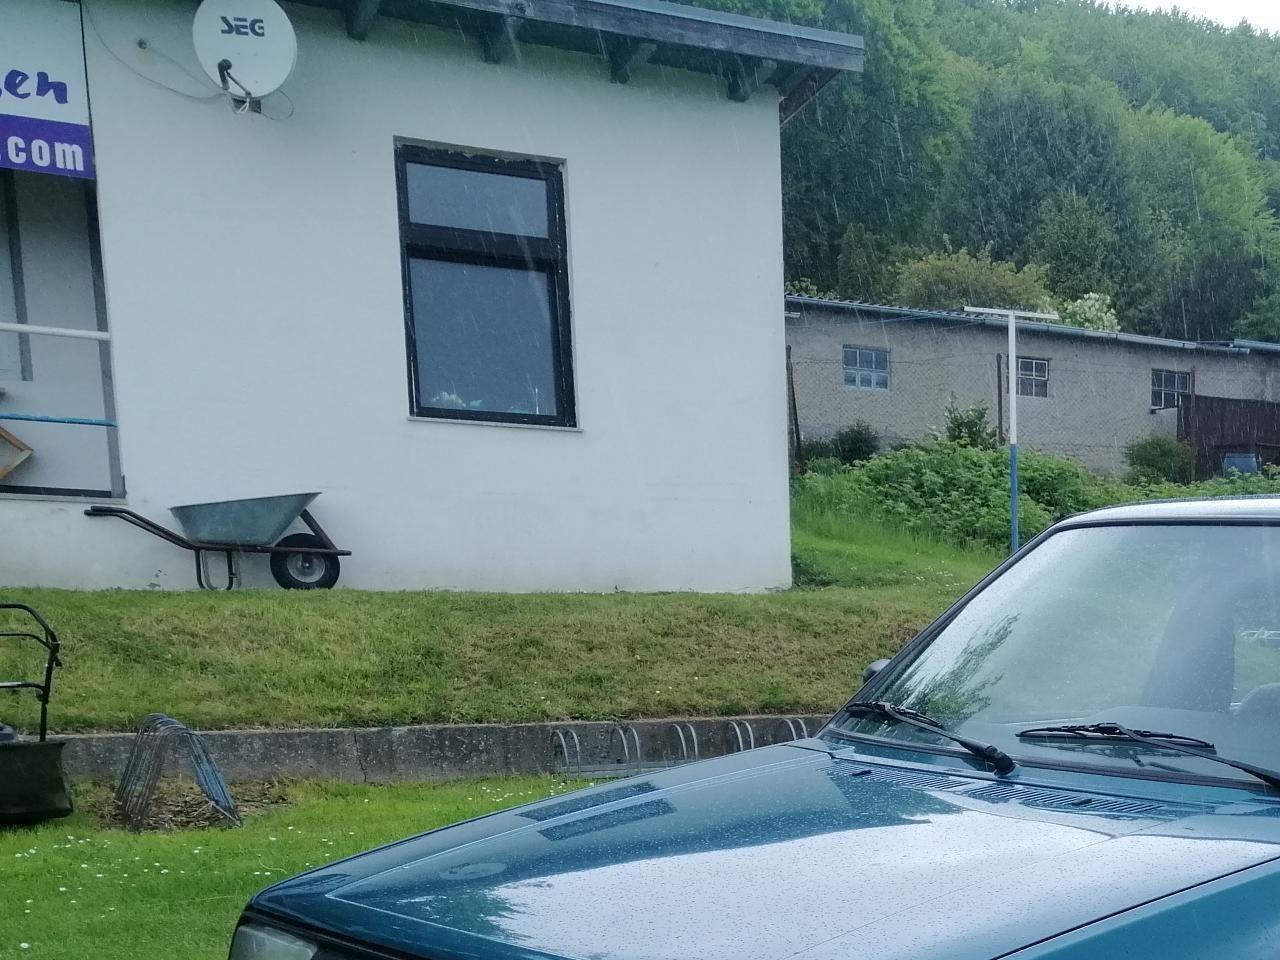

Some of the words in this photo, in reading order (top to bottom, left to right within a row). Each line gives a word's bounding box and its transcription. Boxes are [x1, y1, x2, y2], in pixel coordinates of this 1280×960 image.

[220, 16, 265, 37] SEG
[0, 69, 68, 105] en
[0, 135, 84, 172] com
